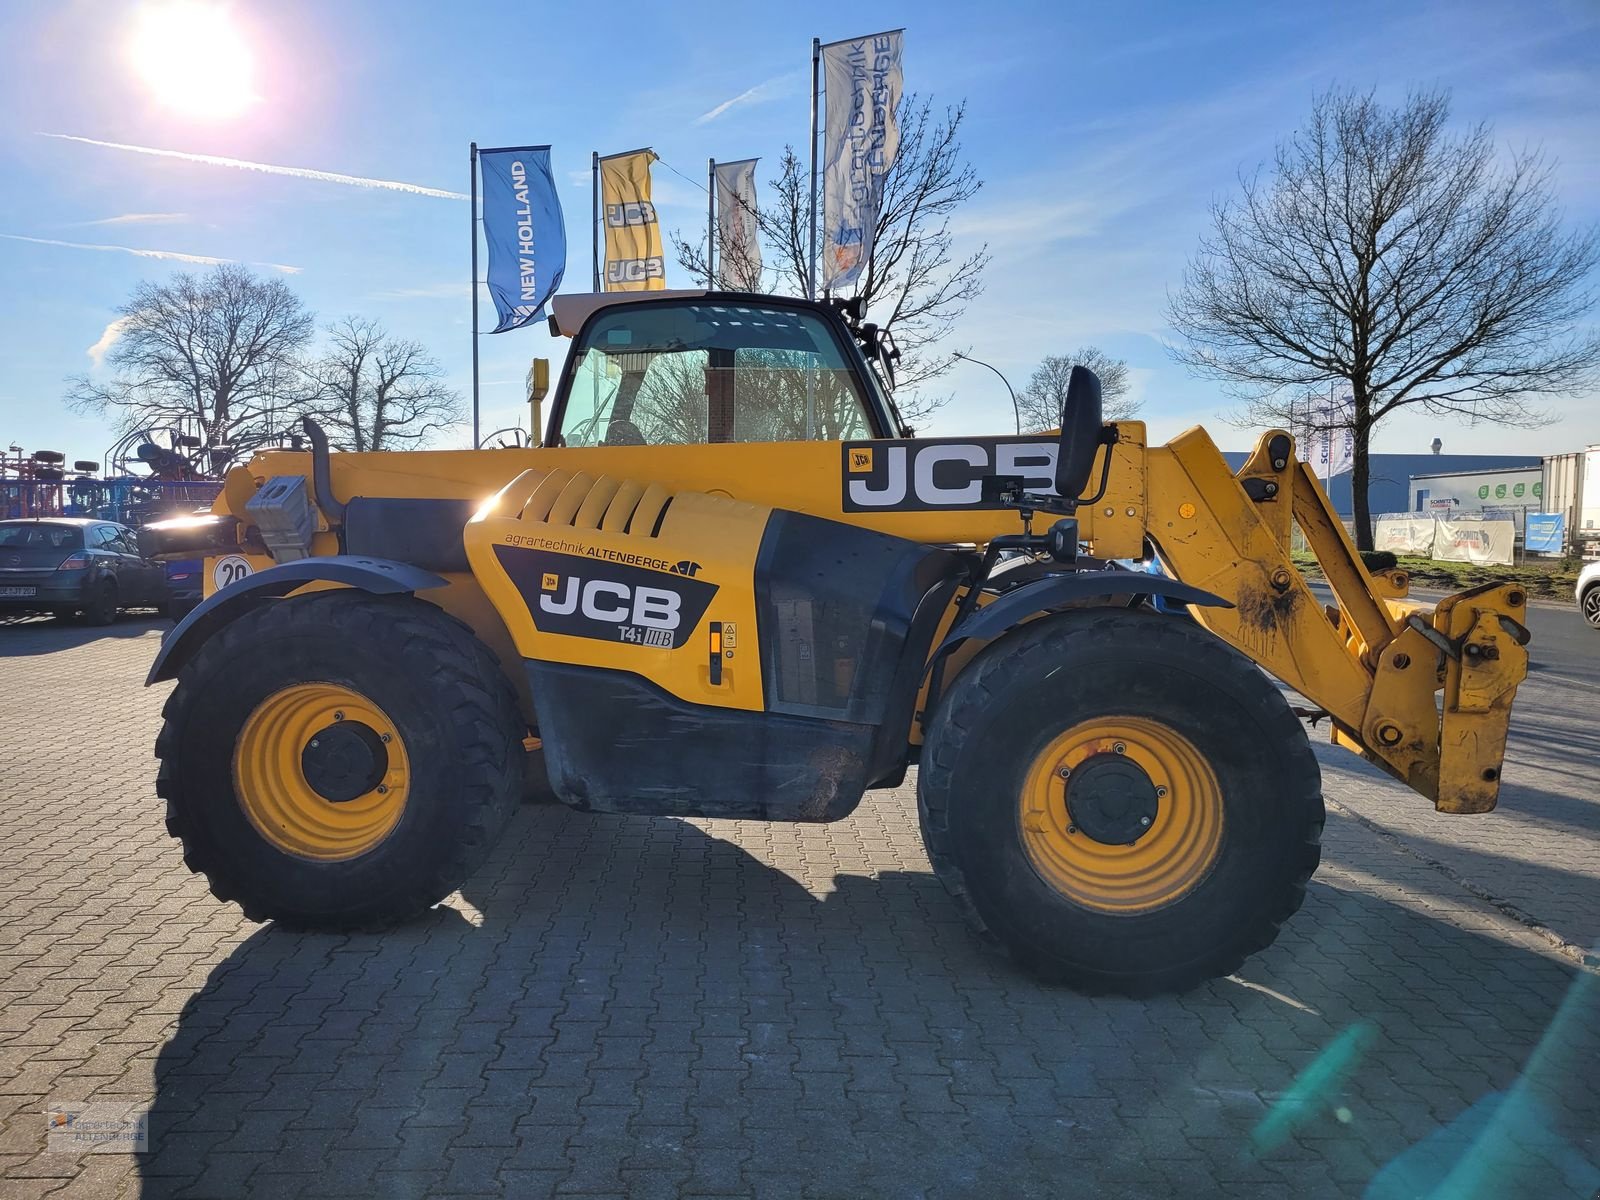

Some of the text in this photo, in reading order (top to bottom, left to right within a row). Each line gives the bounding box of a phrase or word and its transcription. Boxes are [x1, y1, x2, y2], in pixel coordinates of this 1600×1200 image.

[511, 161, 535, 300] NEW HOLLAND
[609, 258, 662, 282] JCB
[849, 443, 1062, 506] JCB
[854, 453, 869, 467] JCB
[505, 533, 669, 571] agrartechnik ALTENBERGE
[222, 563, 247, 587] 20
[540, 576, 682, 630] JCB
[618, 626, 642, 645] T4i
